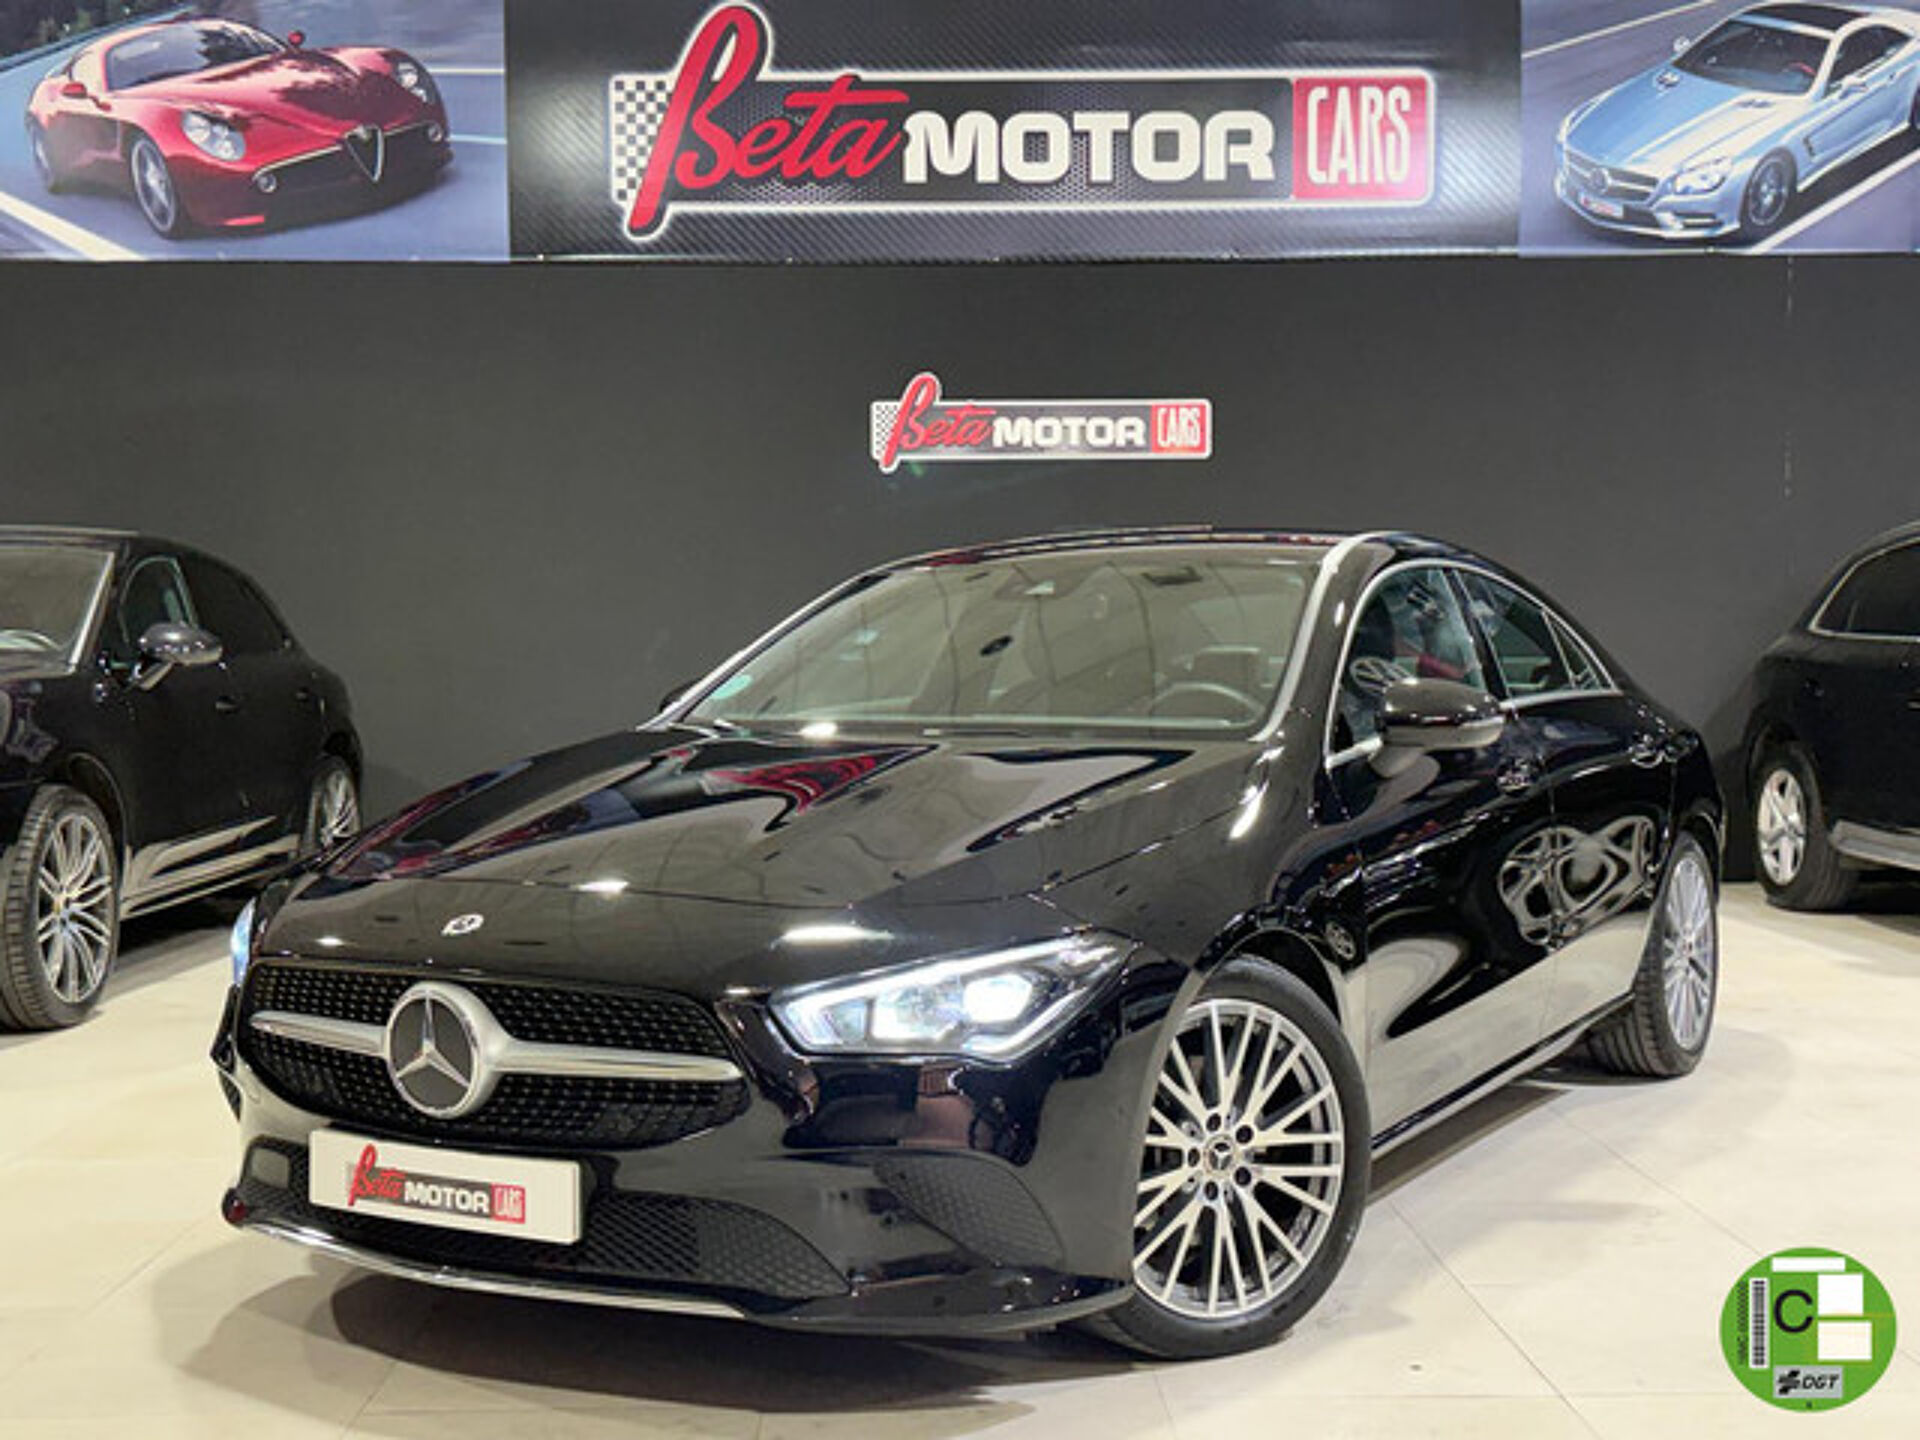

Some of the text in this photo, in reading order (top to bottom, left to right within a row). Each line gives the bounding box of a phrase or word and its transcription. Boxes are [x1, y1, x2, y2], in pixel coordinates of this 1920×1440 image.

[903, 110, 1276, 184] MOTOR
[1307, 83, 1412, 186] CARS
[992, 416, 1146, 448] MOTOR
[1157, 407, 1201, 447] CARS
[404, 1180, 490, 1214] MOTOR
